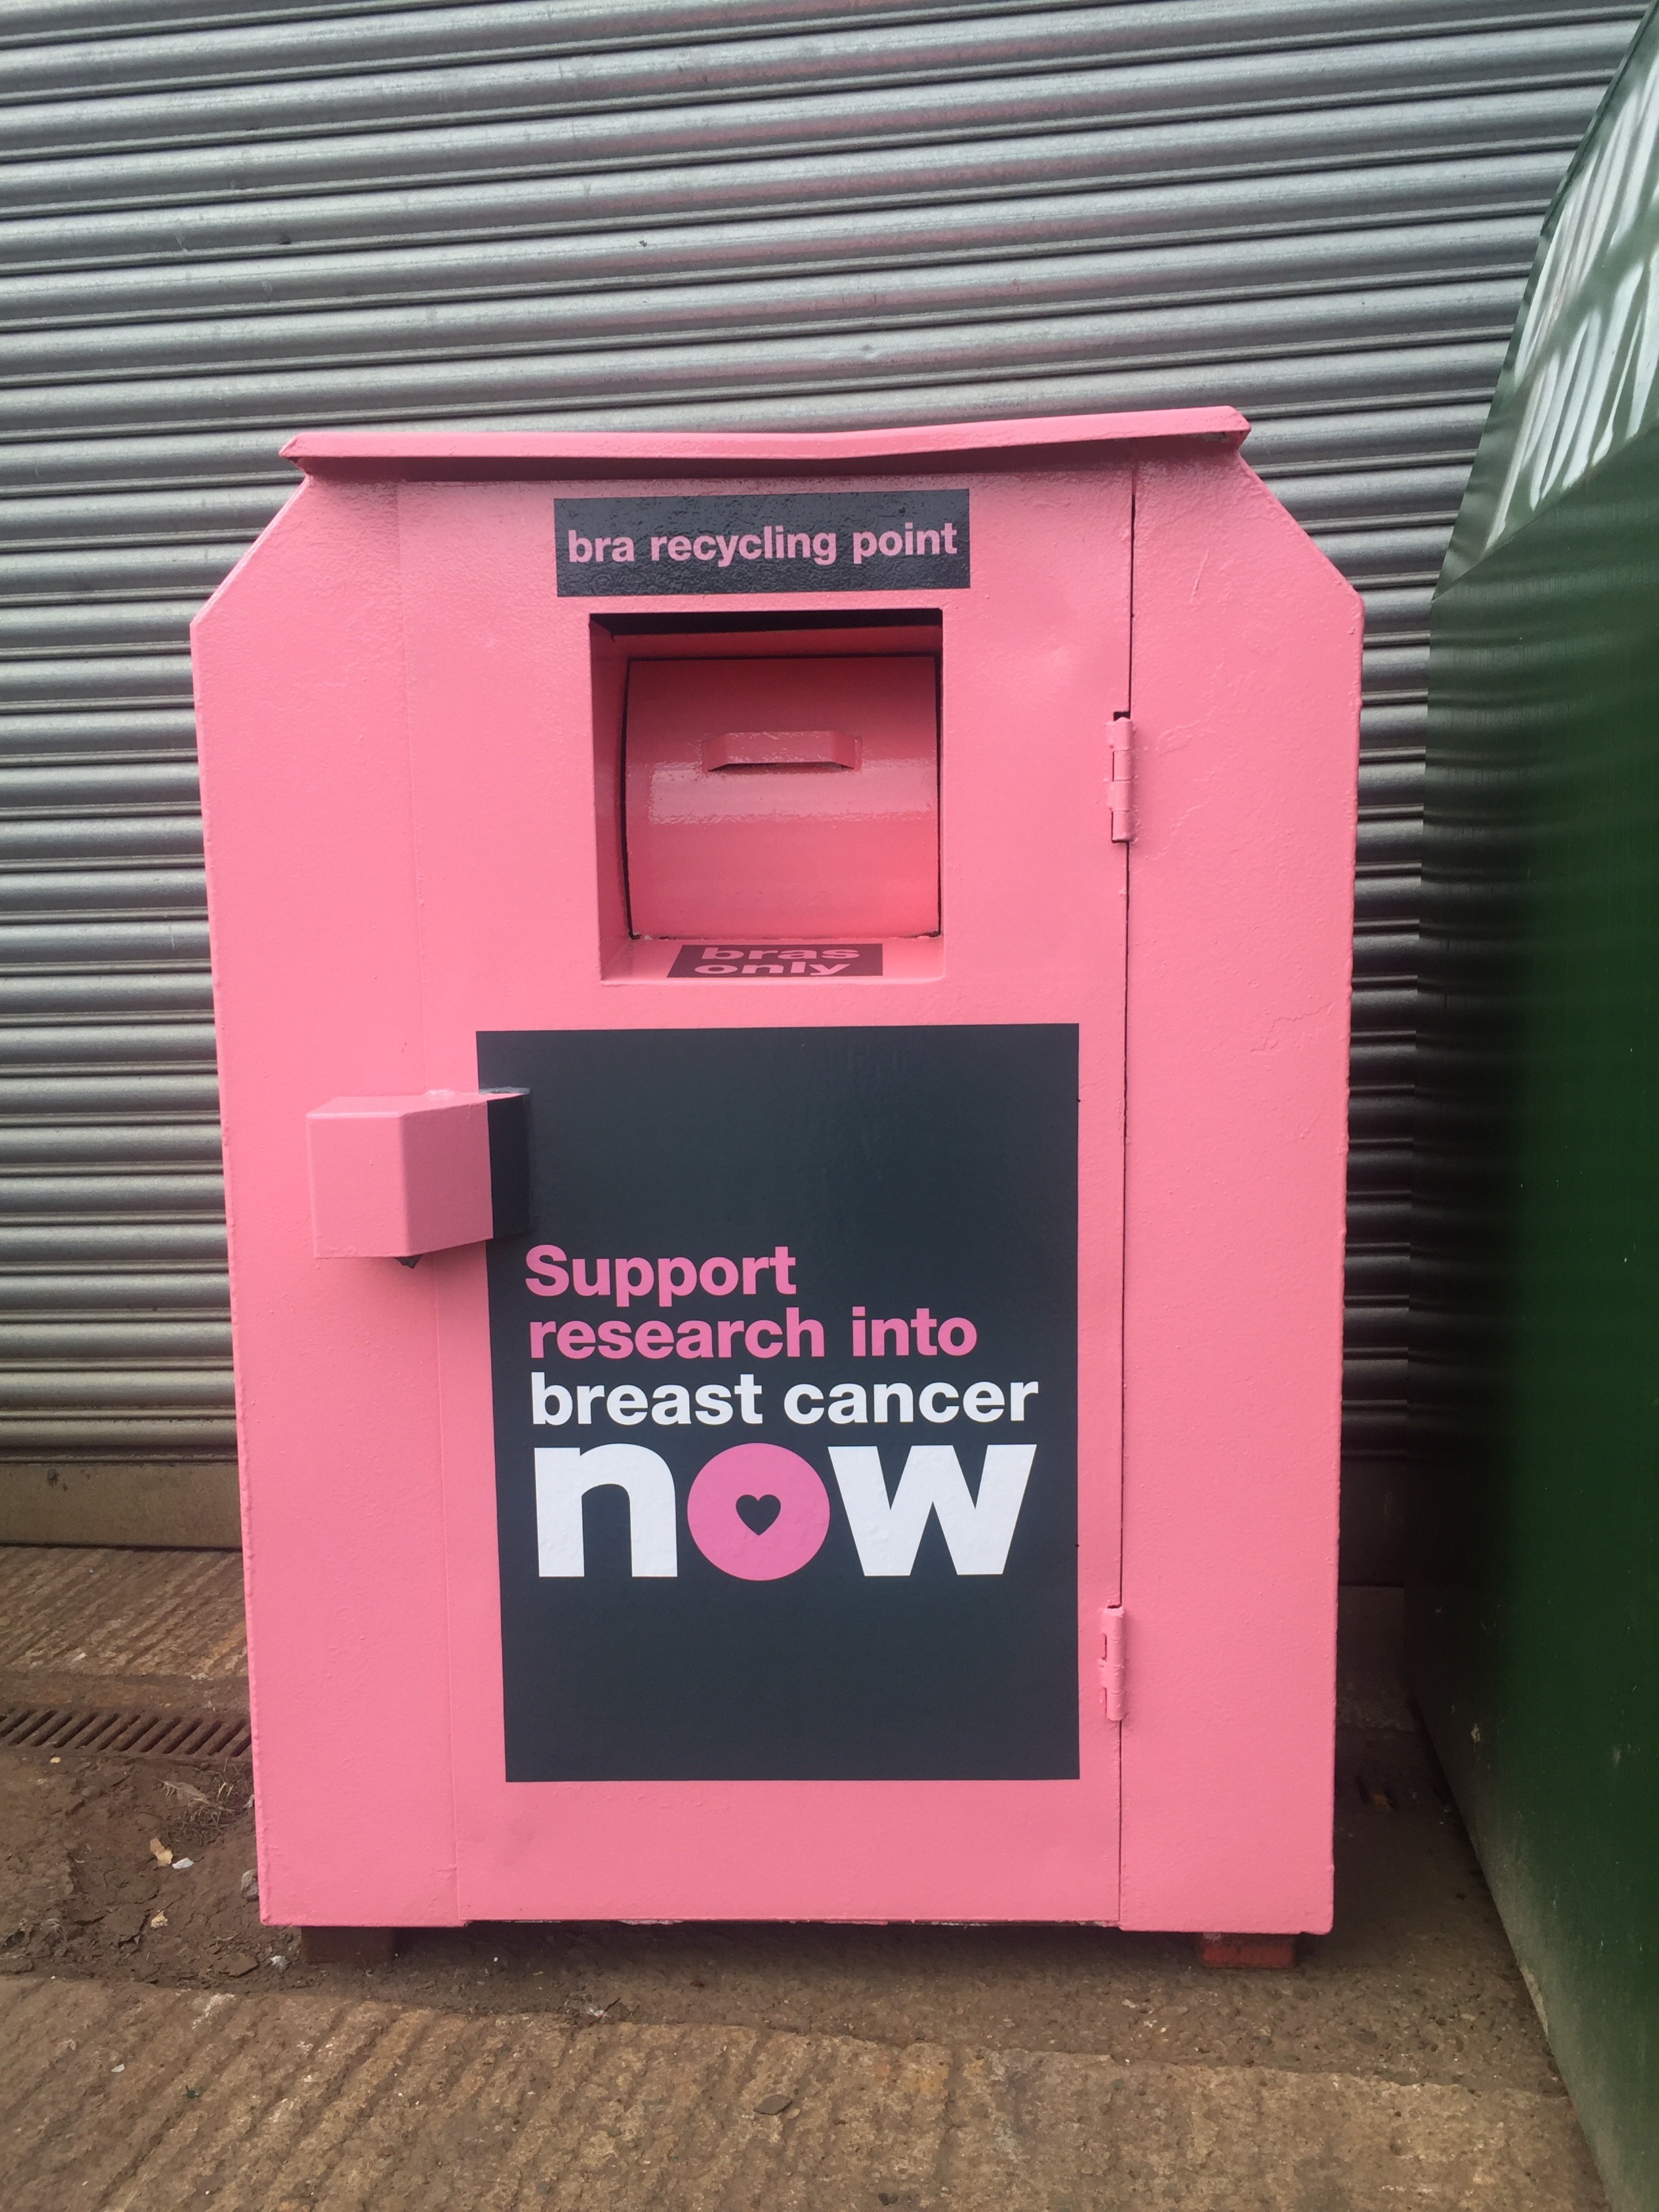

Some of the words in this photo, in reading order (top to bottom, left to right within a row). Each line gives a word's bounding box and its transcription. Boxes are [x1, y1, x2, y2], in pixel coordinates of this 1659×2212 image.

[567, 529, 635, 564] bra
[651, 525, 838, 568] recycling
[853, 522, 958, 564] point
[694, 961, 851, 975] only
[701, 946, 861, 960] bras
[525, 1244, 797, 1307] Support
[529, 1306, 825, 1360] research
[852, 1306, 978, 1357] into
[531, 1372, 764, 1426] breast
[783, 1379, 1040, 1425] cancer
[533, 1441, 1038, 1581] now
